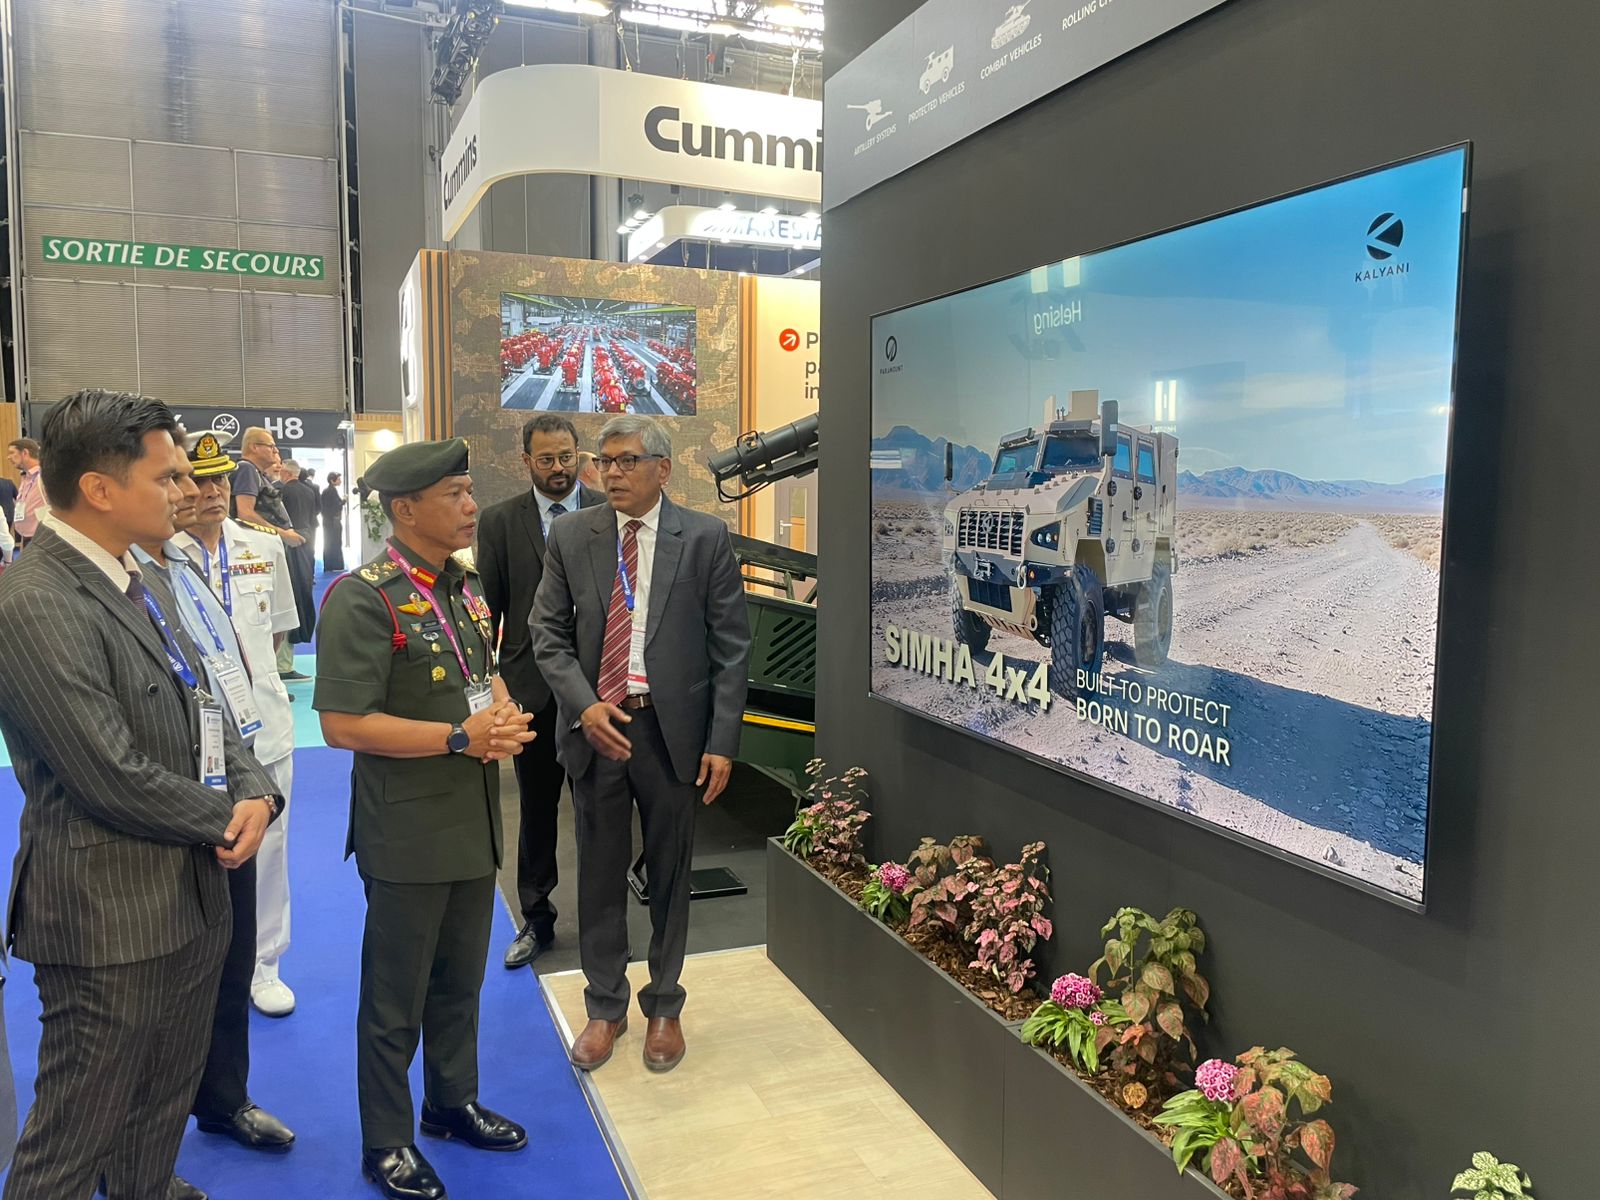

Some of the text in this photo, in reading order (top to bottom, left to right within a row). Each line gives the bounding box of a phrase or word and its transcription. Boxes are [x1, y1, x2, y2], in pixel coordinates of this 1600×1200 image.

[1062, 1, 1097, 30] ROLLING
[980, 33, 1042, 79] COMBAT VEHICLES
[908, 81, 965, 124] PROTECTED VEHICLES
[876, 123, 897, 144] SYSTEMS
[444, 134, 477, 211] Cummins
[46, 239, 321, 277] SORTIE DE SECOURS
[1355, 262, 1410, 282] KALYANI
[805, 361, 820, 378] p
[264, 417, 304, 440] H8
[885, 624, 1051, 710] SIMHA 4x4
[1076, 668, 1231, 727] BUILT TO PROTECT
[1076, 697, 1231, 767] BORN TO ROAR
